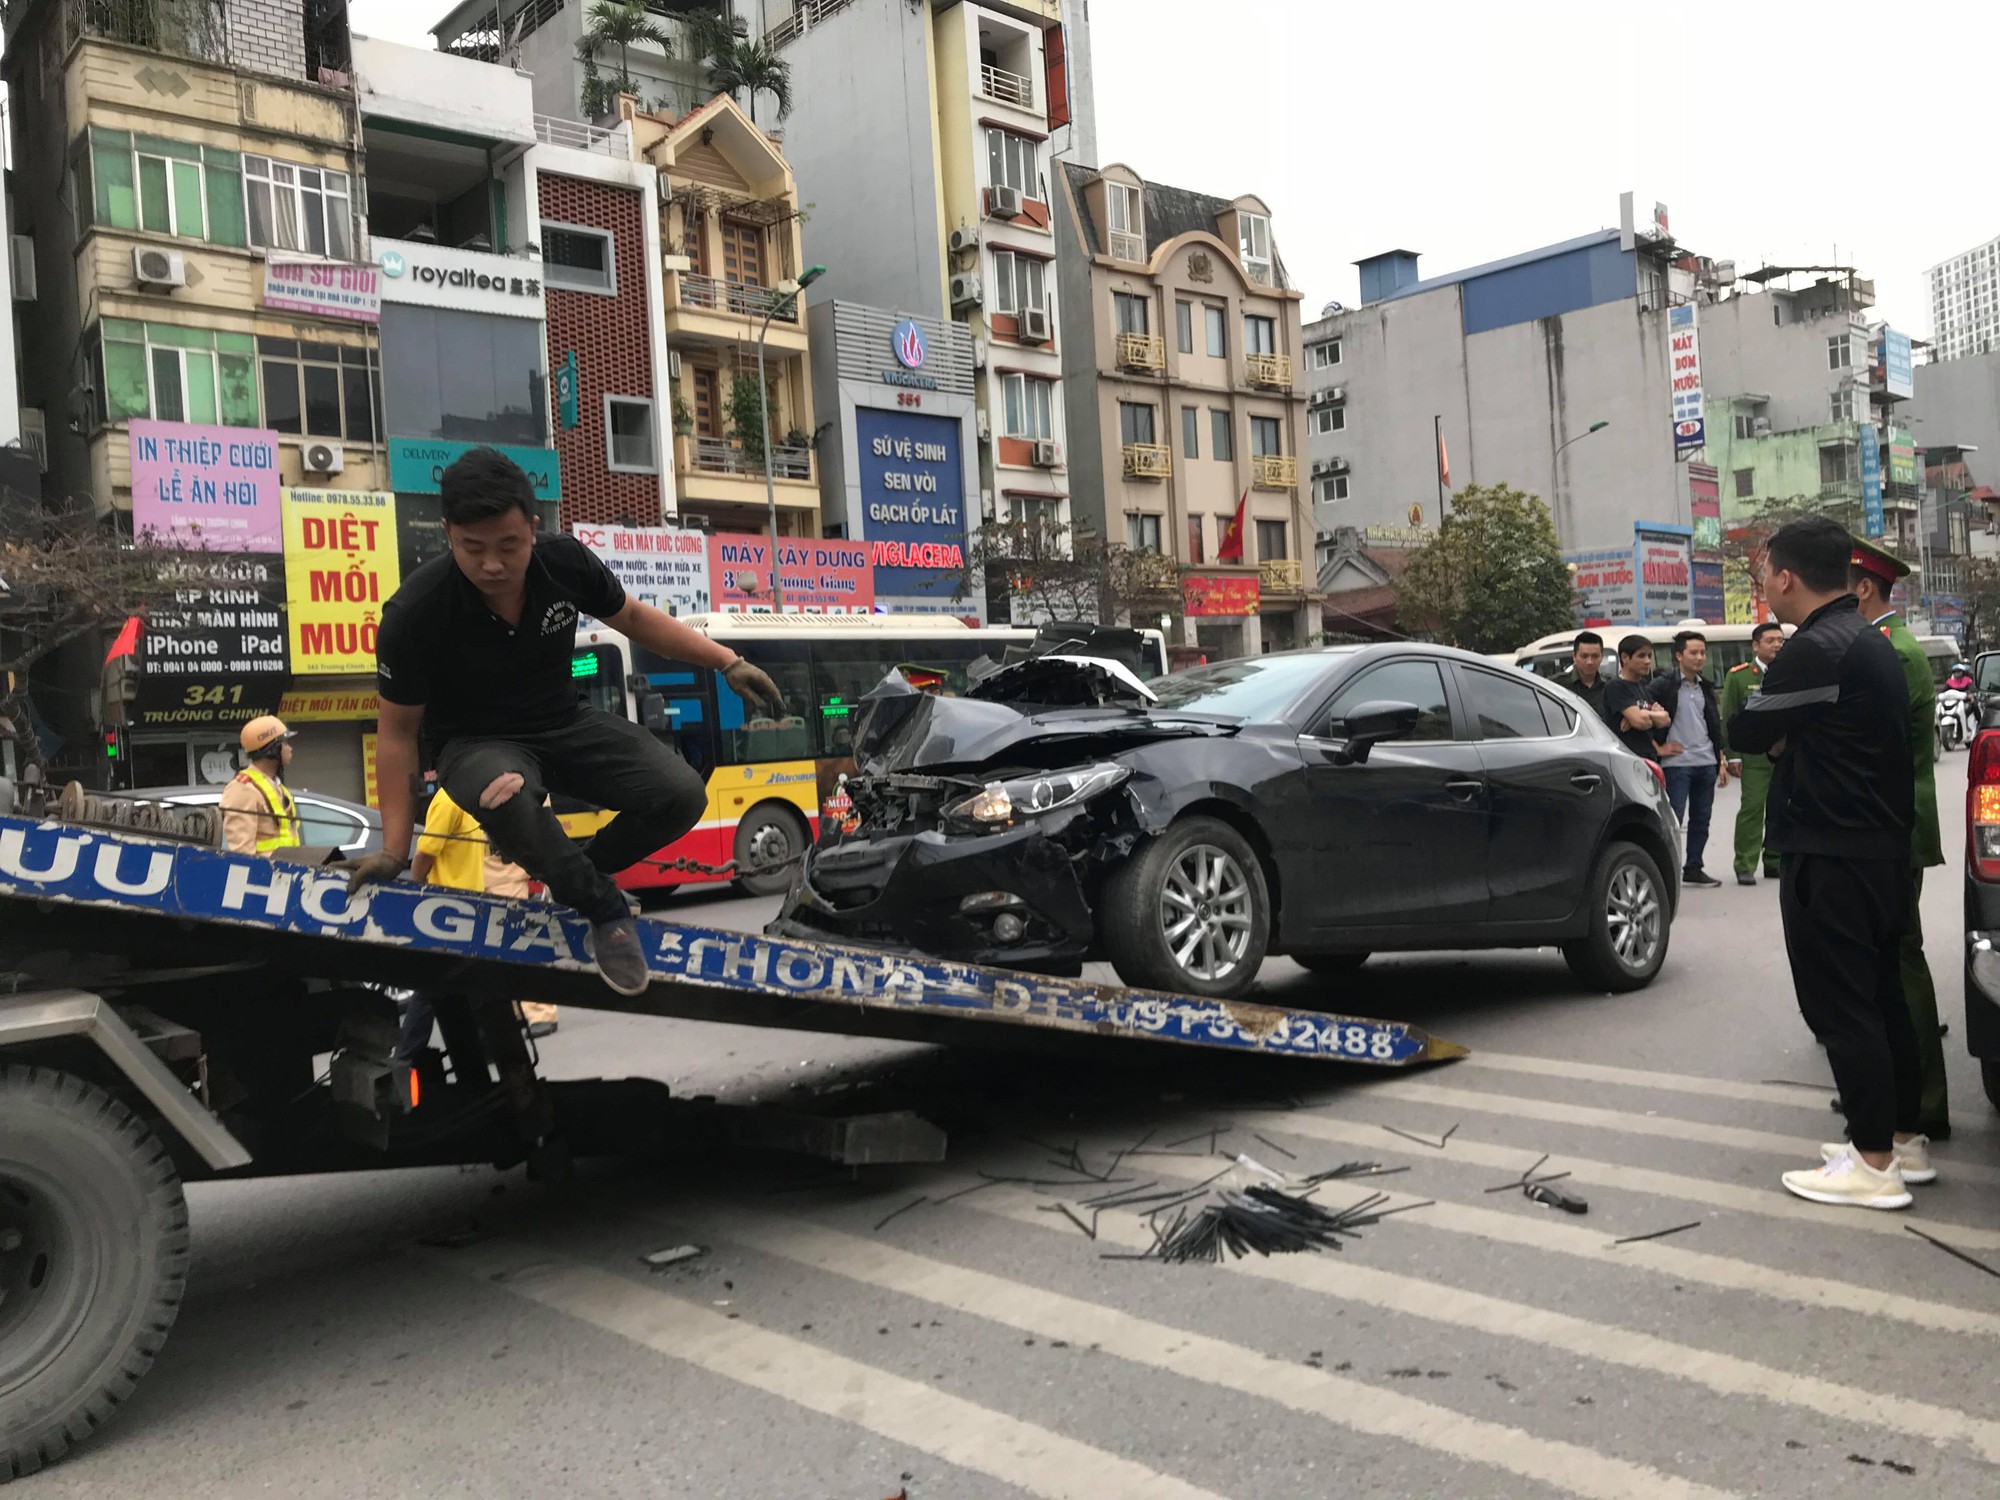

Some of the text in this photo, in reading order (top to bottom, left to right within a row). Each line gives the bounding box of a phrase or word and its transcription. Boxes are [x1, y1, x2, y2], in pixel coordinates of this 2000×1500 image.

[412, 265, 506, 292] royaltea
[138, 436, 273, 471] IN THIỆP CƯỚI
[402, 448, 450, 461] DELIVERY
[872, 434, 947, 462] SỨ VỆ SINH
[190, 474, 217, 504] ĂN
[884, 470, 937, 492] SEN VÒI
[291, 491, 325, 504] Hotline:
[869, 498, 958, 525] GẠCH ỐP LÁT
[302, 512, 379, 558] DIỆT
[636, 530, 654, 551] MÁY
[626, 558, 648, 572] NƯỚC
[655, 559, 672, 572] MÁY
[692, 562, 702, 573] XE
[721, 542, 866, 573] MÁY XÂY DỰNG
[872, 540, 964, 569] VIGLACERA
[309, 559, 379, 603] MỐI
[623, 575, 634, 587] CỤ
[636, 573, 655, 588] ĐIỆN
[677, 576, 691, 586] TAY
[197, 608, 236, 628] MÀN
[240, 609, 279, 628] HÌNH
[300, 611, 379, 656] MUỖ
[147, 635, 283, 656] iPhone iPad
[163, 661, 185, 674] 0941
[187, 661, 199, 673] 04
[201, 660, 223, 673] 0000
[252, 659, 284, 672] 916268
[183, 684, 244, 706] 341
[280, 697, 306, 715] DIỆT
[143, 707, 269, 723] TRƯỜNG CHINH
[221, 863, 371, 936] HỘ
[412, 897, 598, 963] GIA
